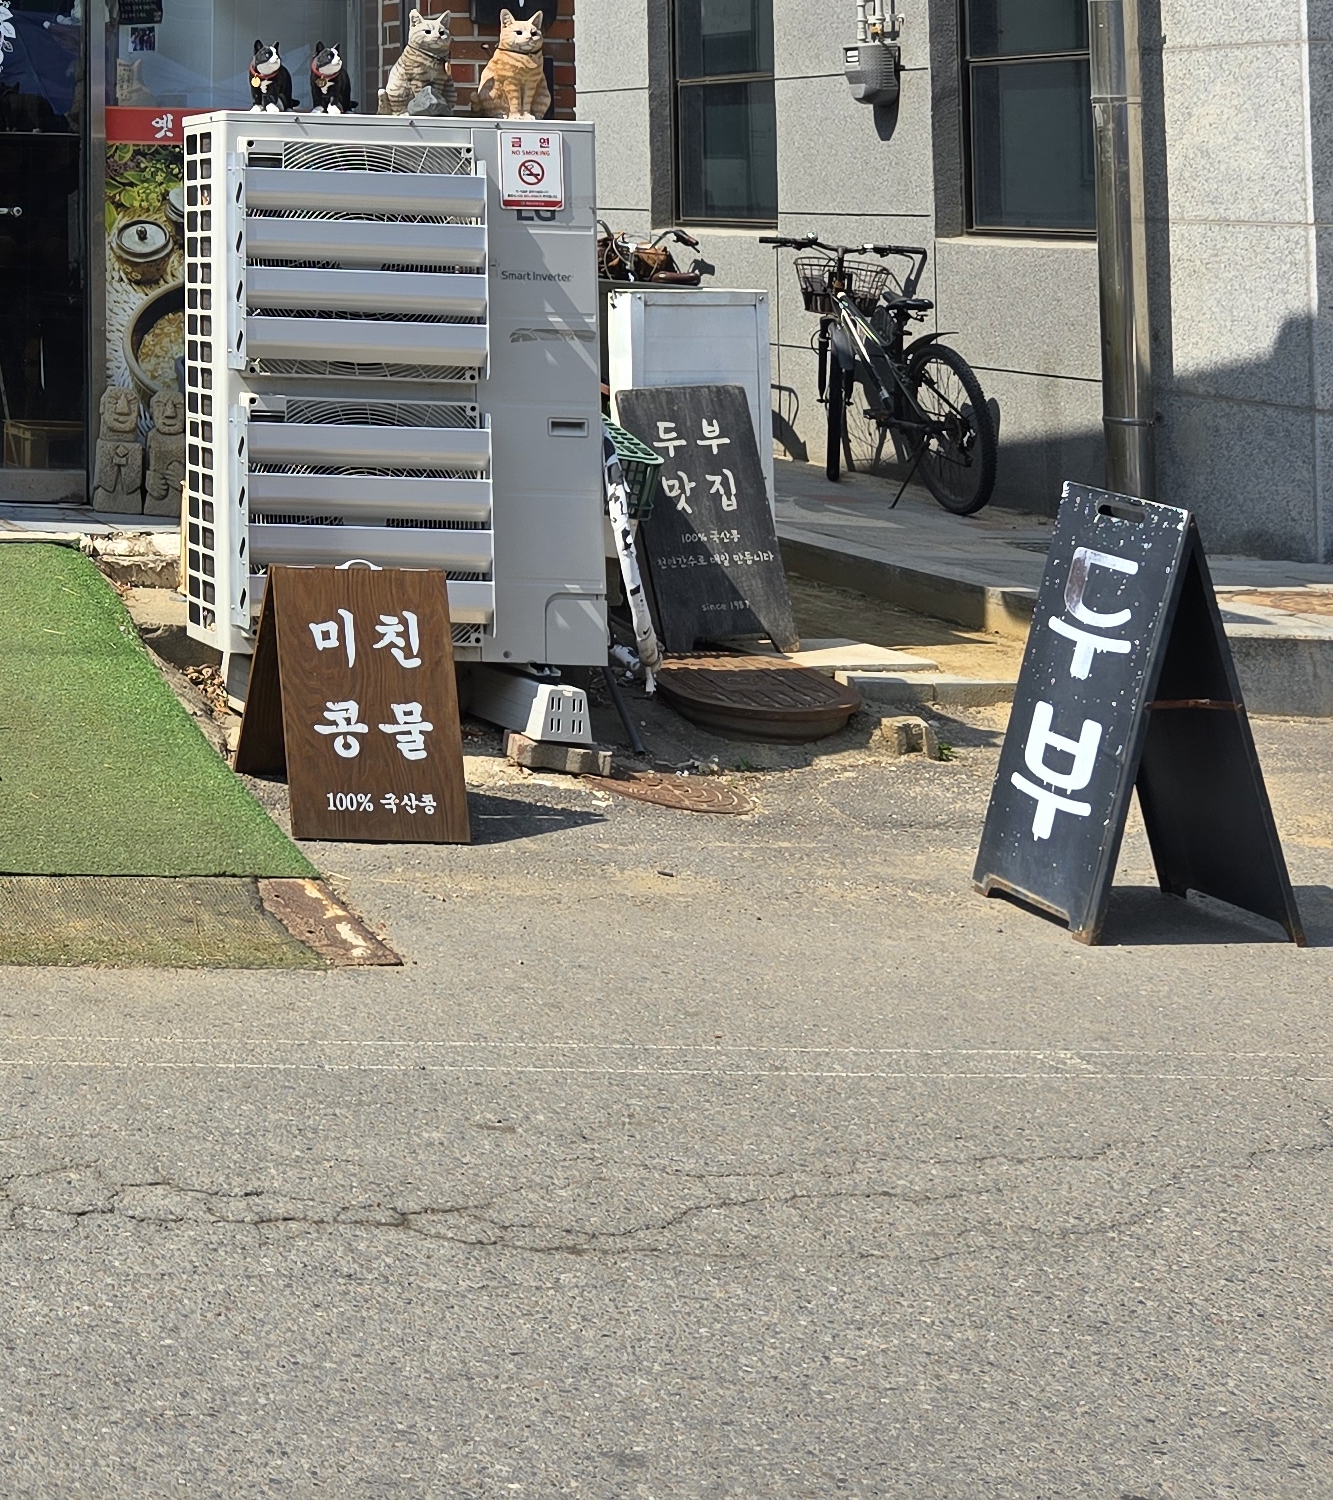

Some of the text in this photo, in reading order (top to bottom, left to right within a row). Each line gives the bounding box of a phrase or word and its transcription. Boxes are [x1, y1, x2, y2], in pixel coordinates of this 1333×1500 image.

[152, 113, 174, 138] 옛
[501, 271, 572, 282] Smart Inverter
[653, 418, 730, 457] 두부
[661, 469, 737, 514] 맛집
[681, 532, 707, 542] 100%
[733, 551, 774, 566] 만듭니다
[701, 602, 727, 611] since
[308, 608, 422, 668] 미친
[1011, 546, 1139, 841] 두부
[313, 699, 434, 761] 콩물
[327, 792, 437, 815] 100% 국산콩
